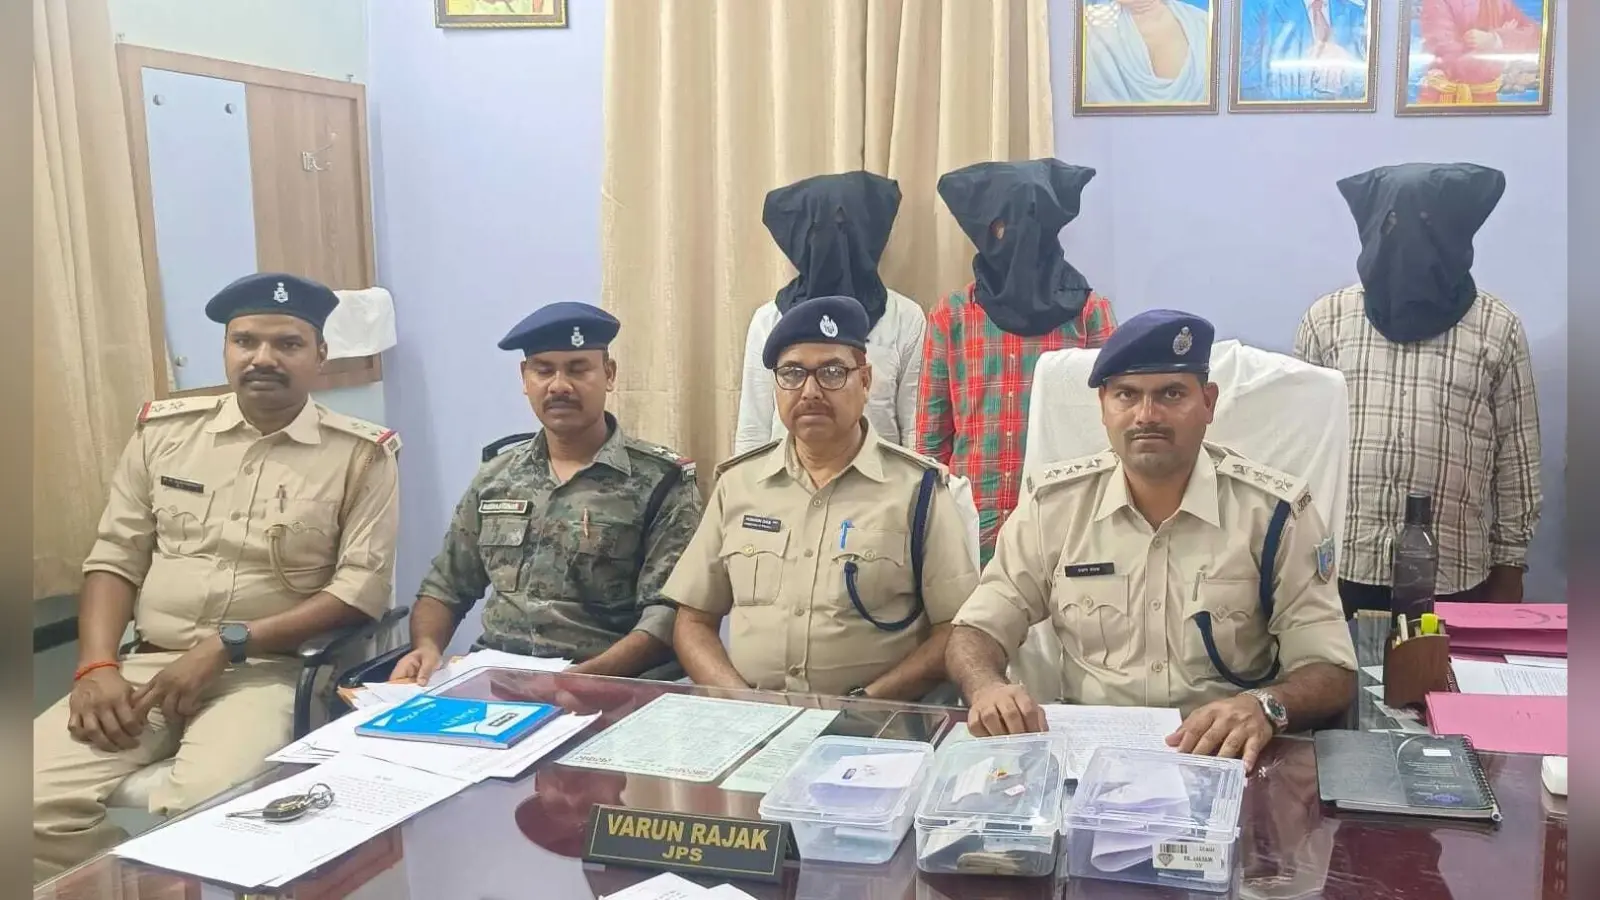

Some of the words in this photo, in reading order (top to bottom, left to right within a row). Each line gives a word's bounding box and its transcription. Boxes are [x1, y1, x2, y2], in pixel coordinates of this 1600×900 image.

[607, 813, 684, 843] VARUN
[691, 823, 770, 851] RAJAK
[662, 845, 703, 862] JPS
